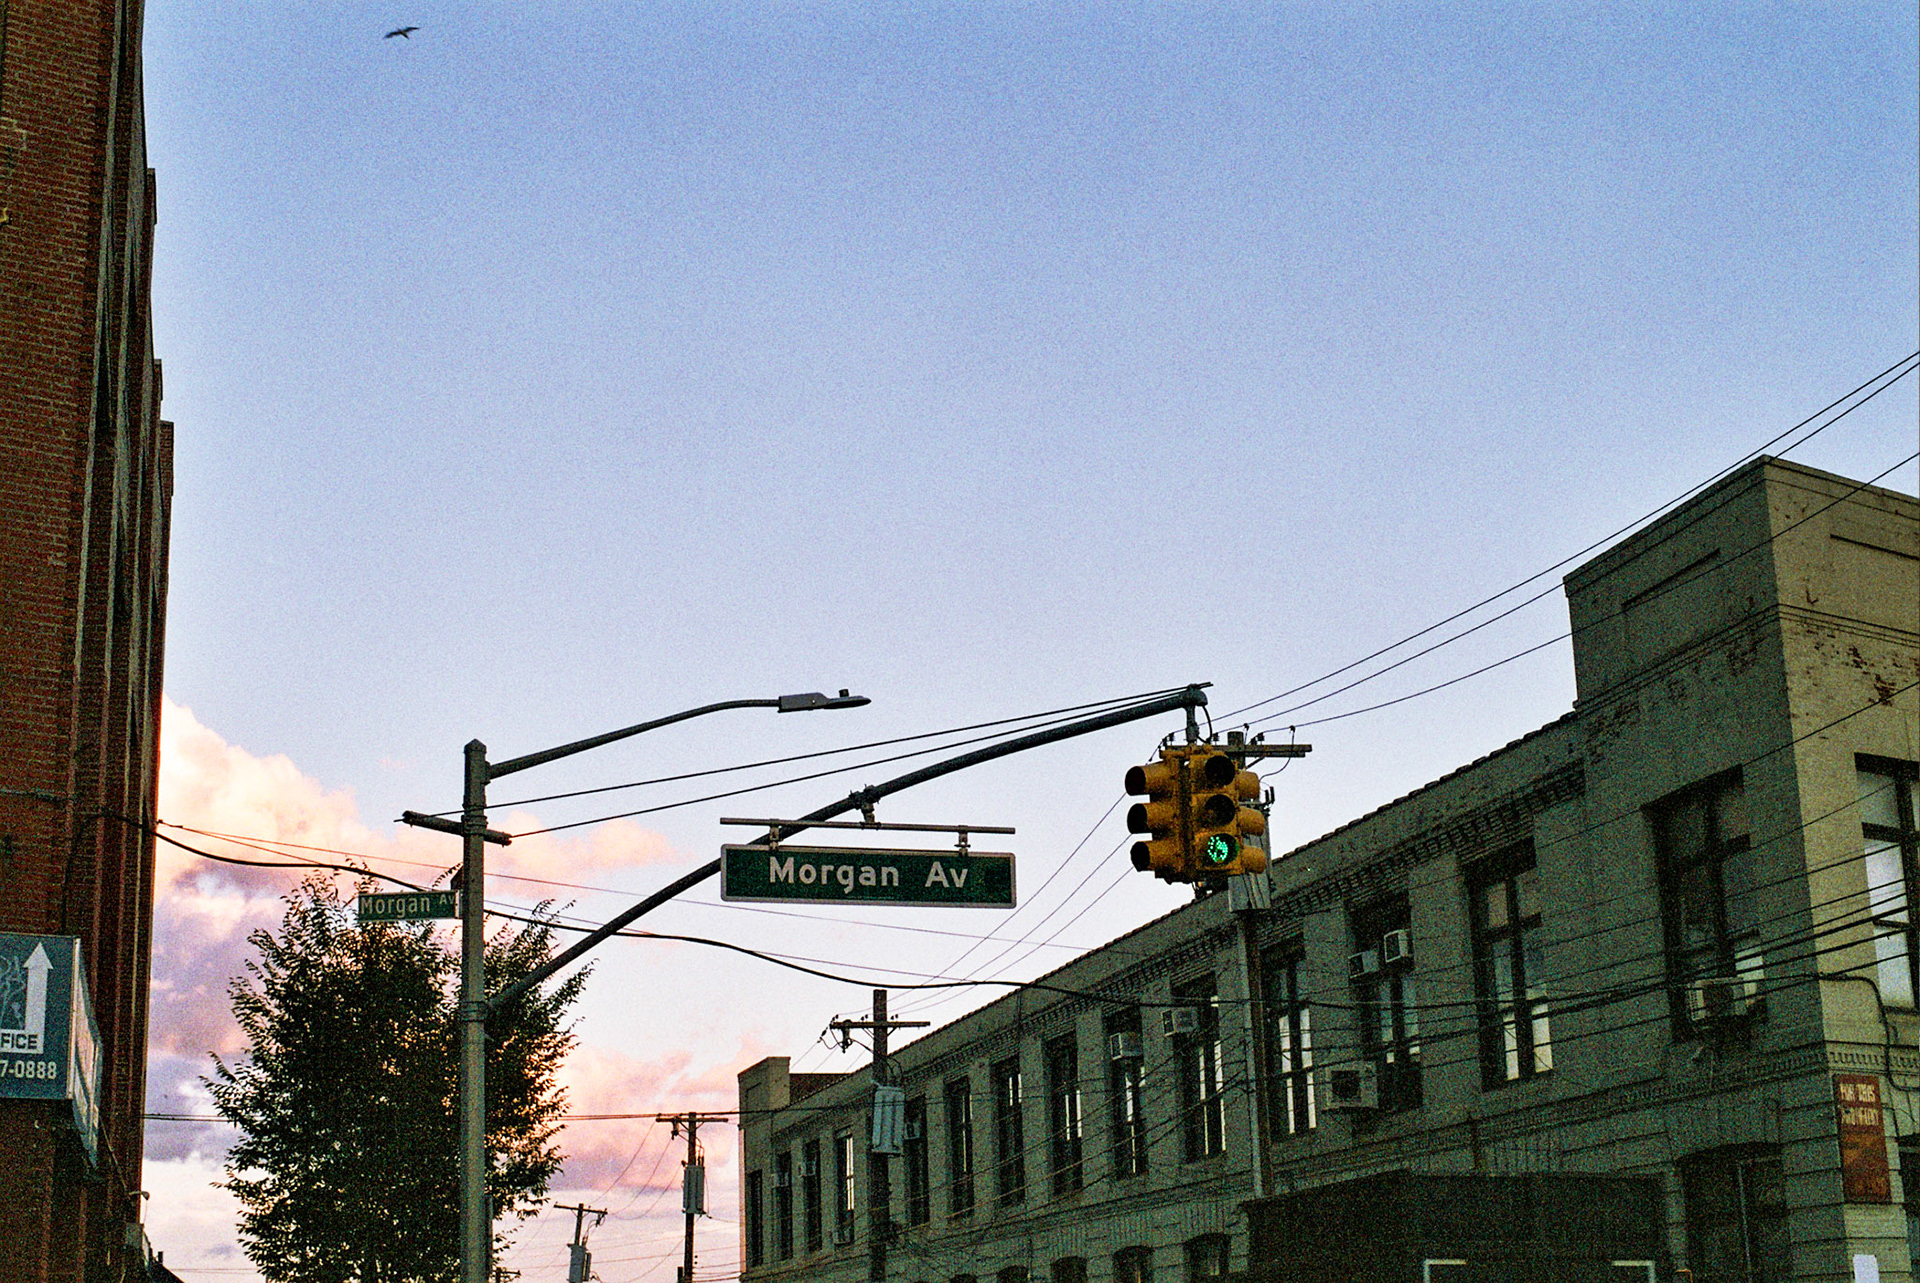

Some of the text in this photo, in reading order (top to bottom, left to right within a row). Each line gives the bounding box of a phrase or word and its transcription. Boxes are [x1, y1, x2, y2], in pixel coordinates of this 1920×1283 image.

[769, 857, 968, 894] Morgan Av
[360, 893, 455, 918] Morgan Av
